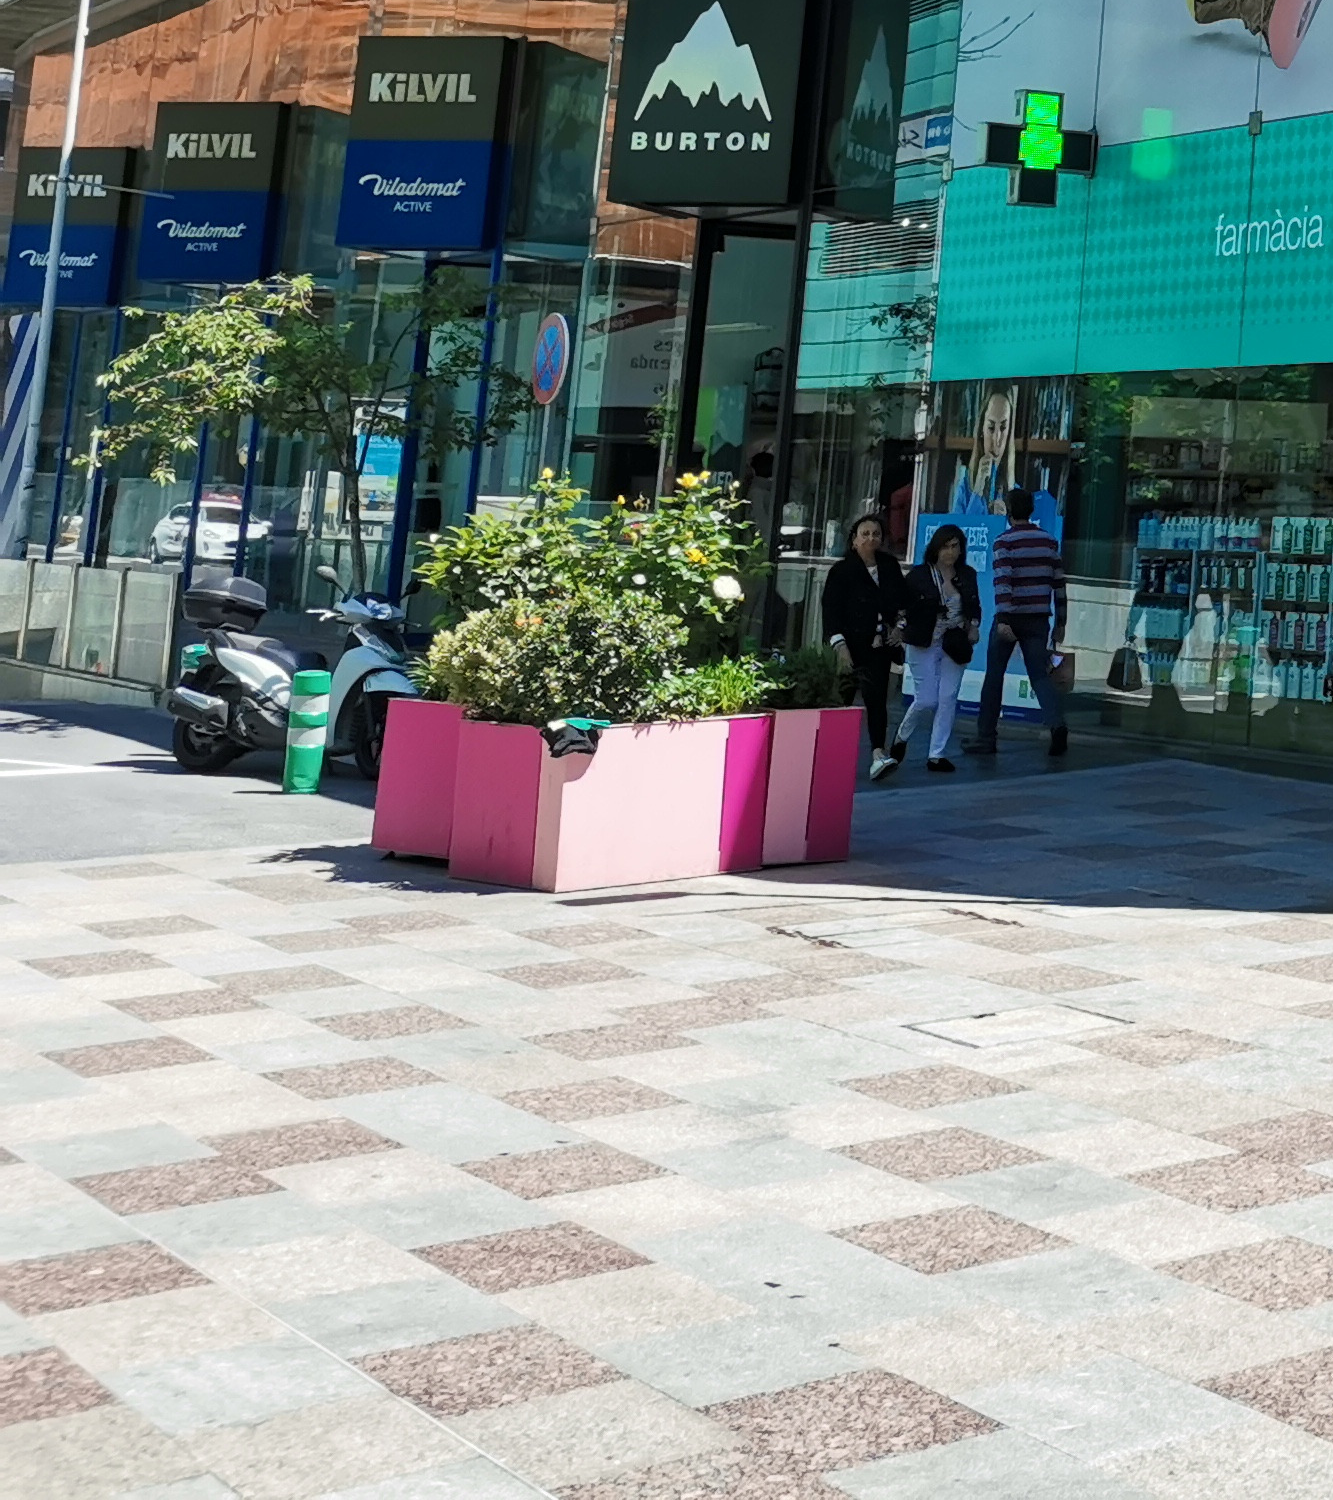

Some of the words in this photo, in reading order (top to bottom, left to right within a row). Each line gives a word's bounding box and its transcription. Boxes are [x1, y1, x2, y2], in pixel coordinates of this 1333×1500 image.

[630, 132, 770, 151] BURTON
[359, 173, 466, 197] Viladomat
[393, 201, 432, 212] ACTIVE
[157, 219, 247, 238] Viladomat
[1215, 205, 1323, 256] farmàcia
[185, 242, 218, 252] ACTIVE
